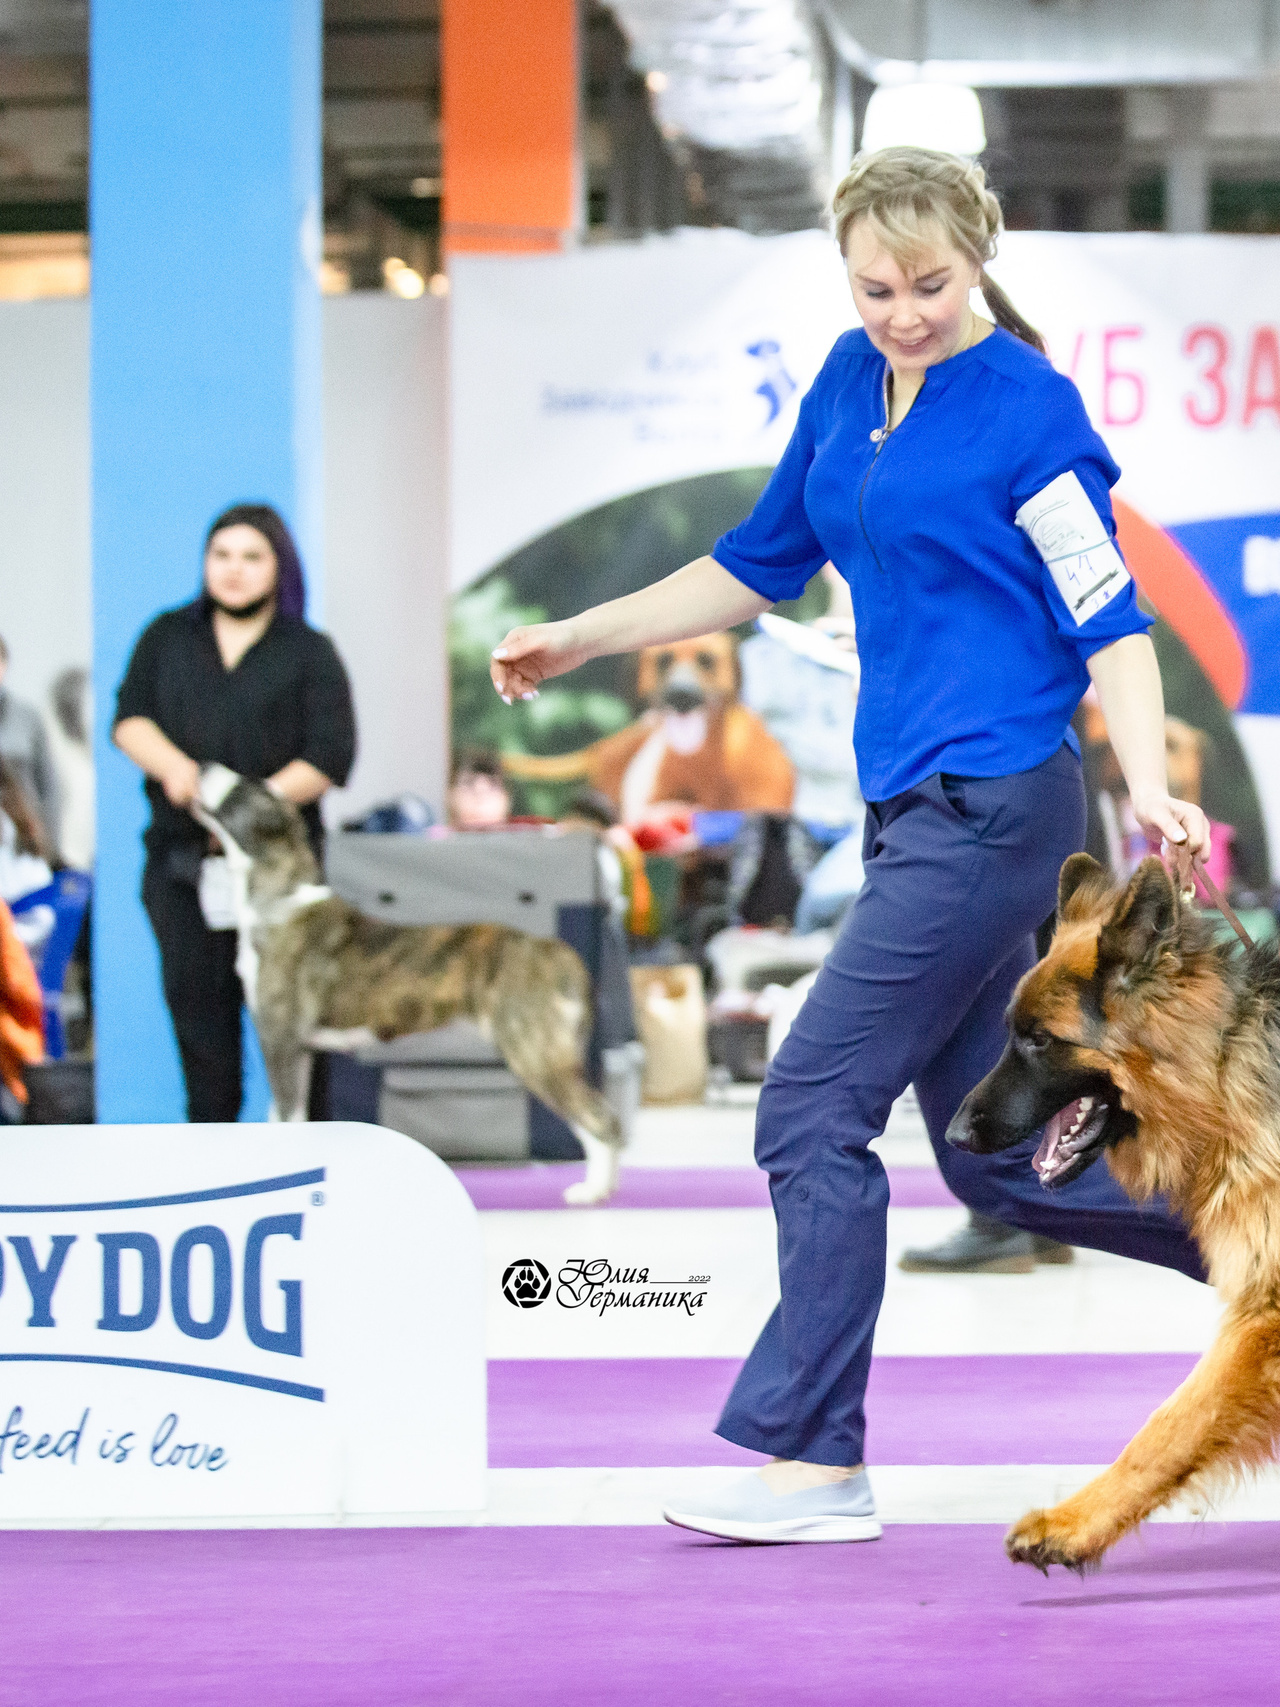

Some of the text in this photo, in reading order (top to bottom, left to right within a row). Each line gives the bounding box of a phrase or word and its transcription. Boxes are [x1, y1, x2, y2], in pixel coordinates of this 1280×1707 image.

[0, 1213, 304, 1357] Y DOG
[0, 1405, 229, 1473] feed is love
